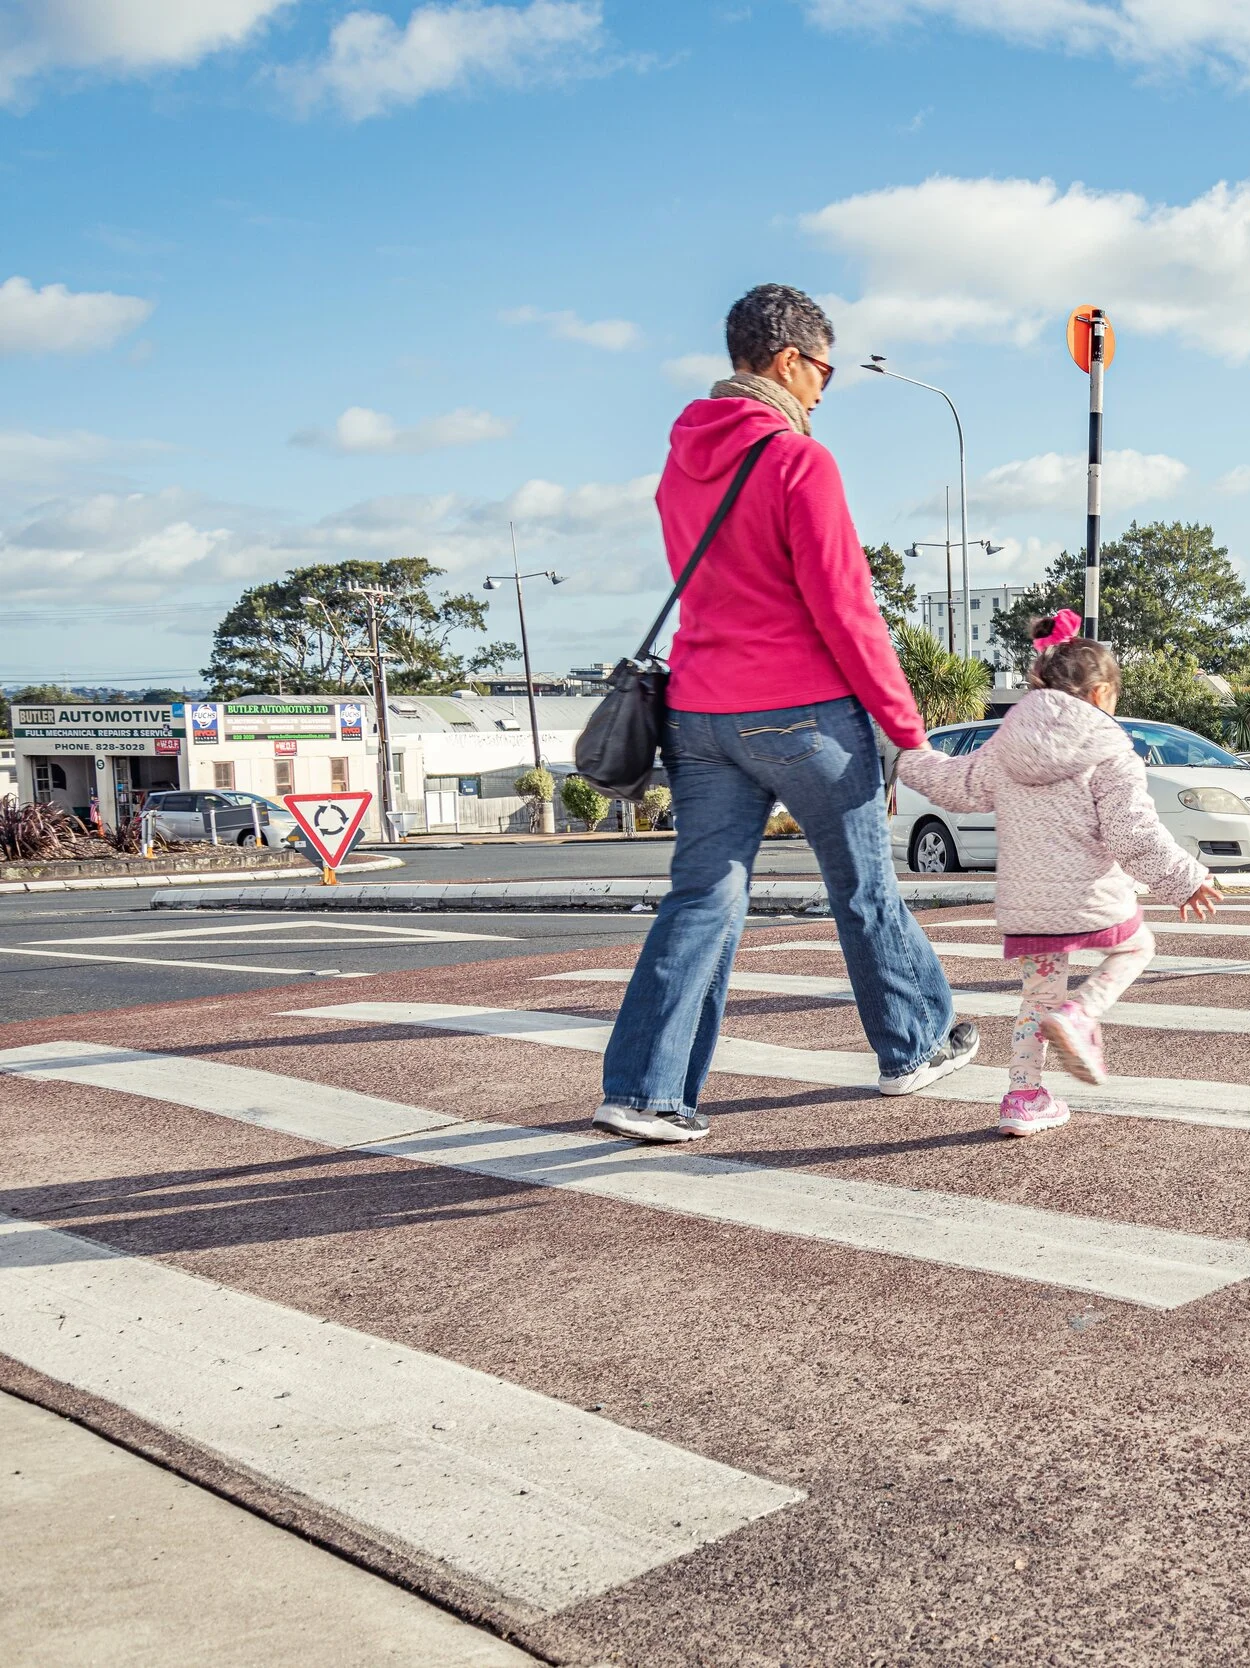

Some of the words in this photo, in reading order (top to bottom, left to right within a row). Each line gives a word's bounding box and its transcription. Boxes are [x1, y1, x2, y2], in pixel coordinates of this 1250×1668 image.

[227, 705, 260, 714] BUTLER
[260, 705, 312, 714] AUTOMOTIVE
[313, 705, 329, 714] LTD
[20, 710, 54, 723] BUTLER
[58, 711, 171, 723] AUTOMOTIVE
[54, 743, 93, 751] PHONE.
[95, 743, 145, 751] 828-3028
